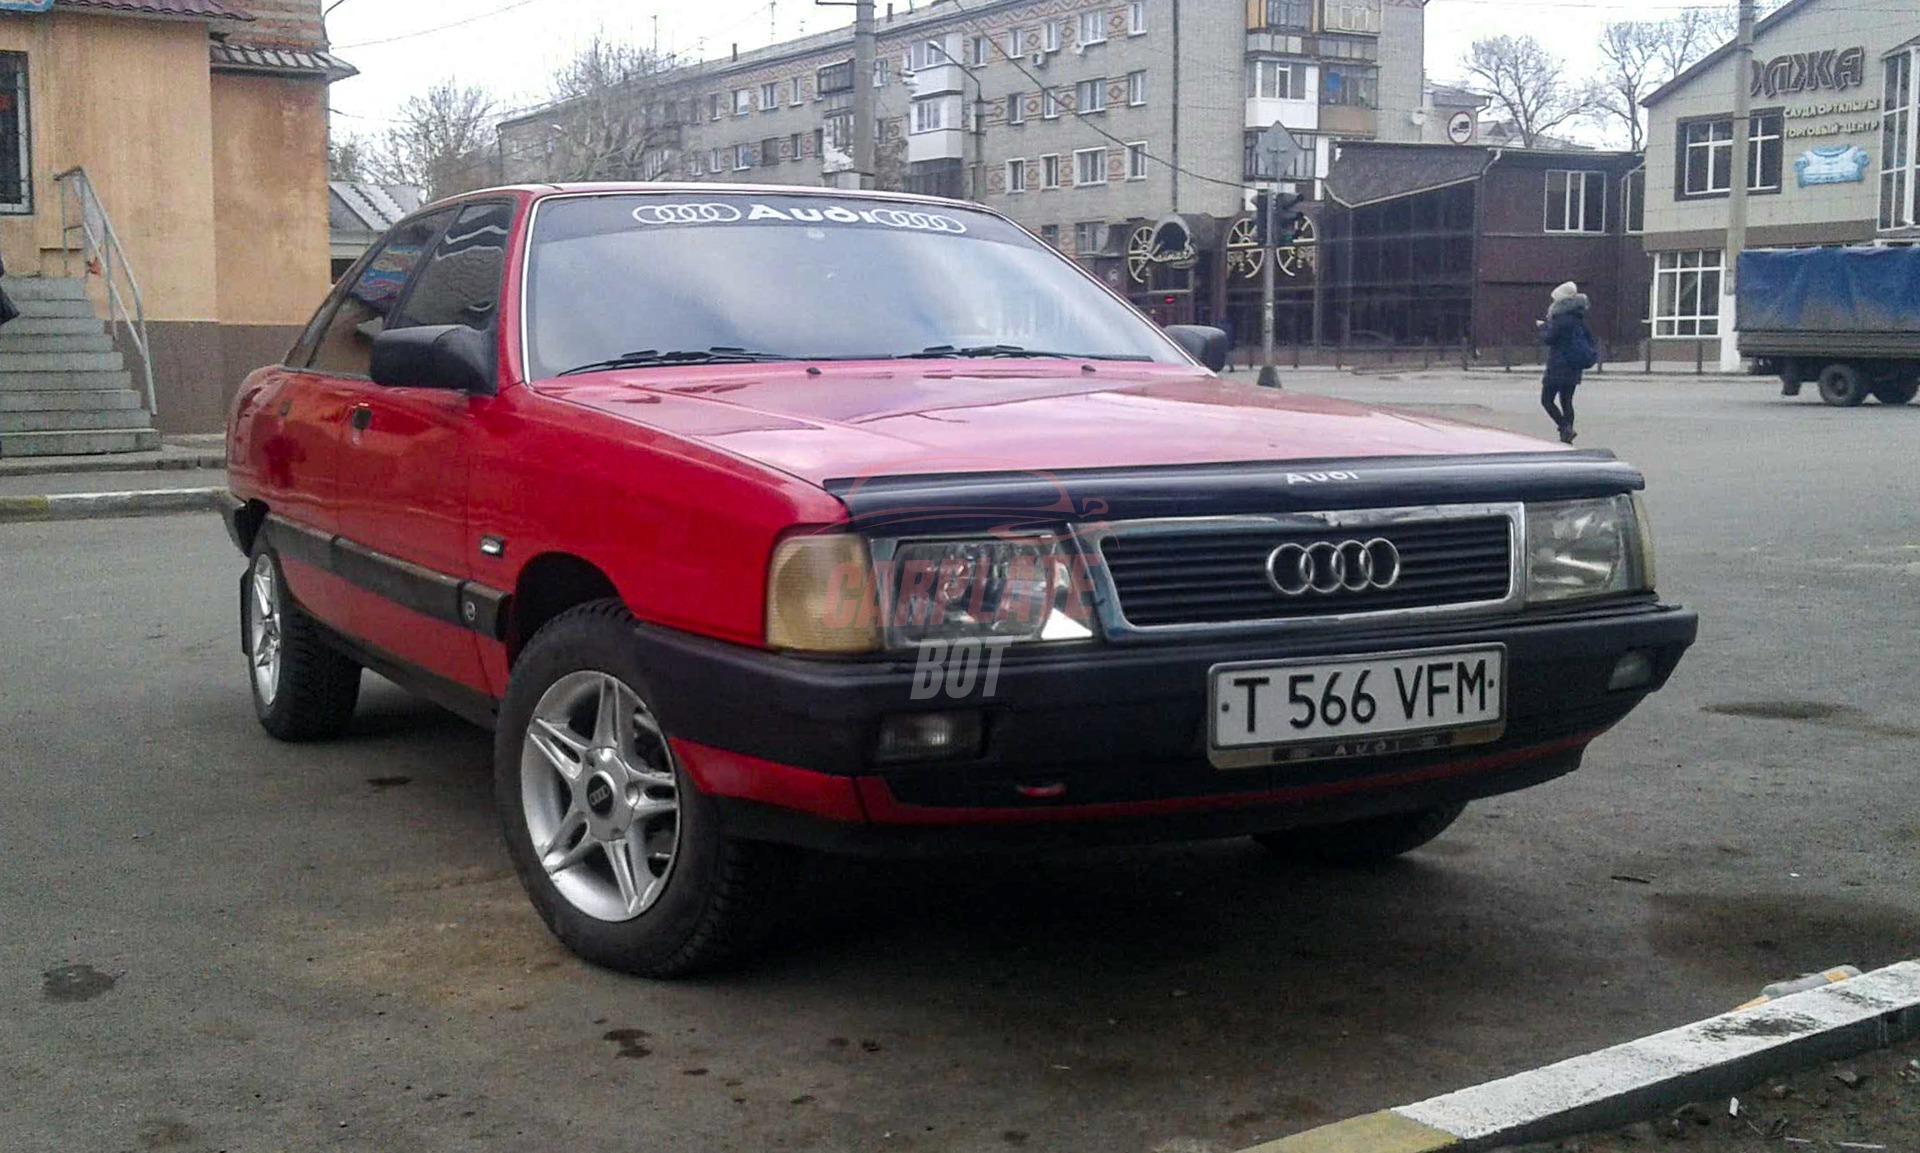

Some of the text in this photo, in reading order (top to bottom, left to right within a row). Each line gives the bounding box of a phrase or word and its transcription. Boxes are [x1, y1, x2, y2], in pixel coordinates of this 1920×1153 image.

[749, 203, 876, 223] Audi
[1233, 659, 1486, 733] T 566 VFM
